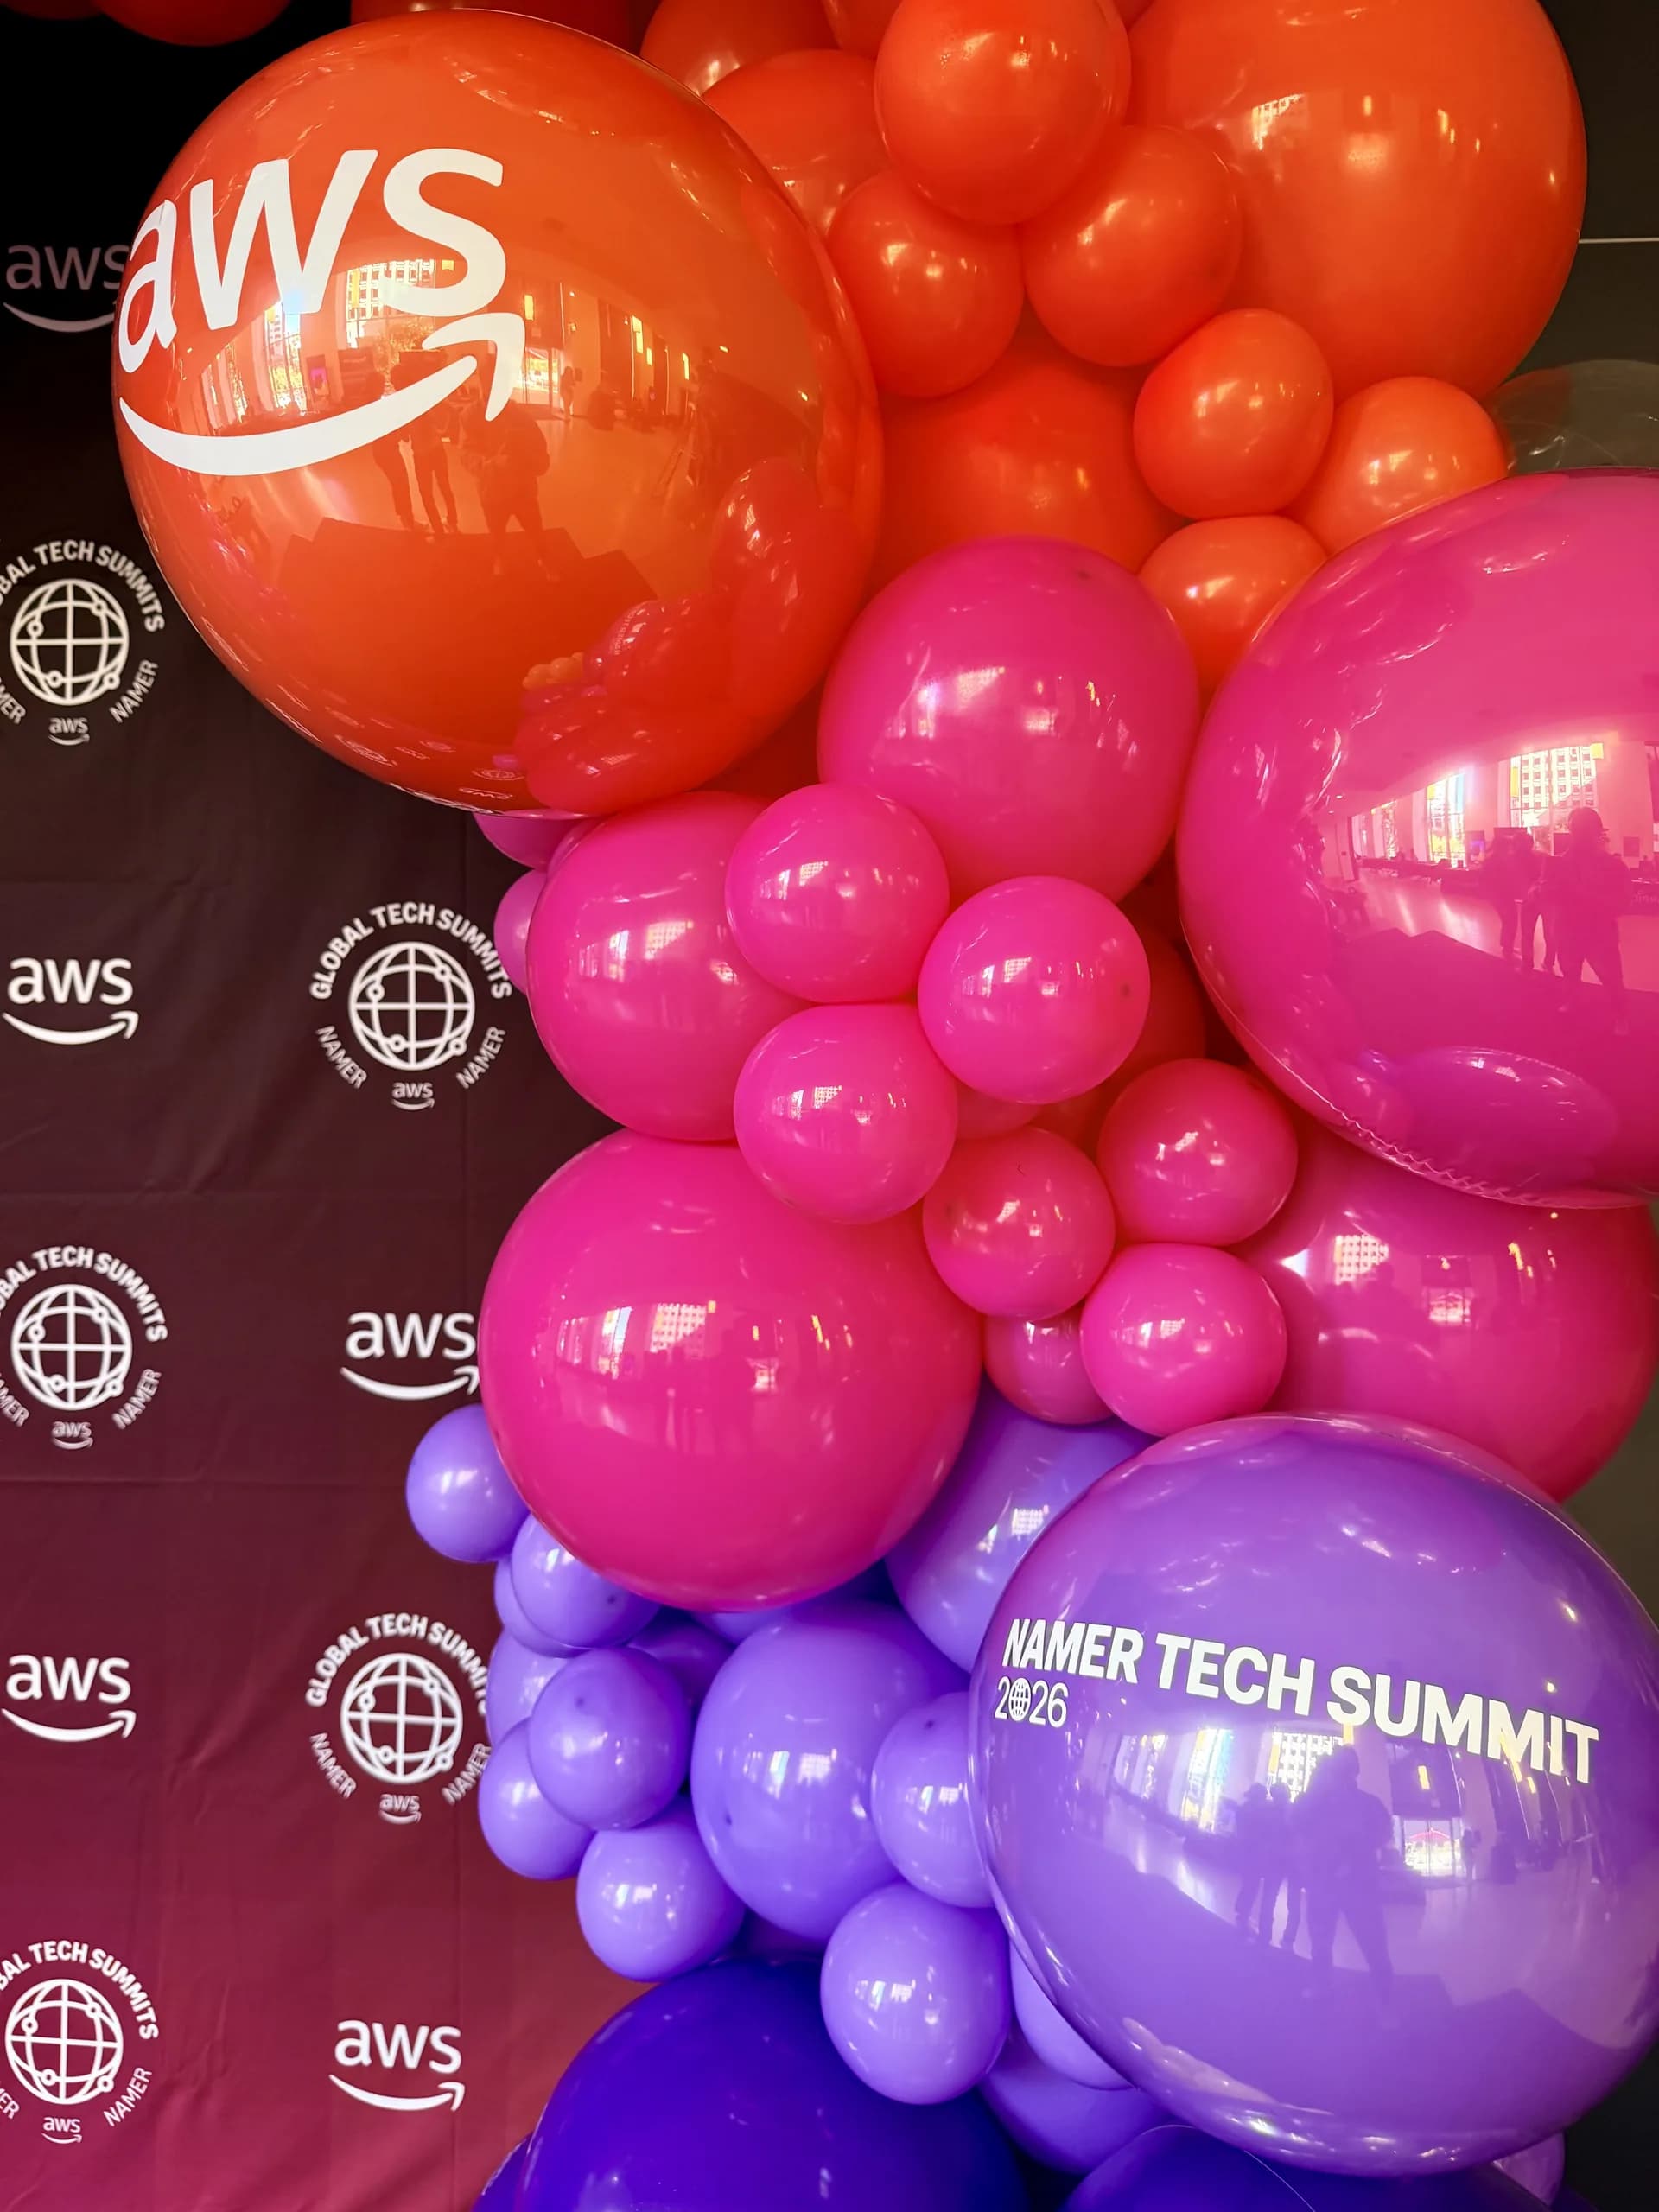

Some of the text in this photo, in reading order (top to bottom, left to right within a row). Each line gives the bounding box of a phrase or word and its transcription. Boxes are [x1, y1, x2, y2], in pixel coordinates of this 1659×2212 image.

[6, 245, 130, 290] aws
[119, 148, 507, 372] aws
[33, 539, 95, 566] TECH
[94, 545, 165, 632] SUMMITS
[109, 659, 158, 723] NAMER
[48, 717, 89, 734] aws
[7, 957, 134, 1005] aws
[309, 901, 512, 1000] GLOBAL TECH SUMMITS
[315, 1025, 367, 1090] NAMER
[455, 1026, 506, 1090] NAMER
[391, 1082, 434, 1099] aws
[31, 1245, 94, 1271] TECH
[93, 1252, 168, 1342] SUMMITS
[346, 1311, 476, 1360] aws
[51, 1421, 92, 1439] aws
[111, 1369, 162, 1430] NAMER
[6, 1654, 131, 1704] aws
[305, 1626, 369, 1707] GLOBAL
[365, 1612, 429, 1640] TECH
[1002, 1618, 1599, 1783] NAMER TECH SUMMIT
[309, 1732, 357, 1799] NAMER
[441, 1743, 492, 1805] NAMER
[379, 1793, 421, 1812] aws
[28, 1940, 89, 1964] TECH
[88, 1948, 159, 2040] SUMMITS
[334, 2019, 461, 2074] aws
[43, 2116, 81, 2133] aws
[103, 2067, 153, 2126] NAMER
